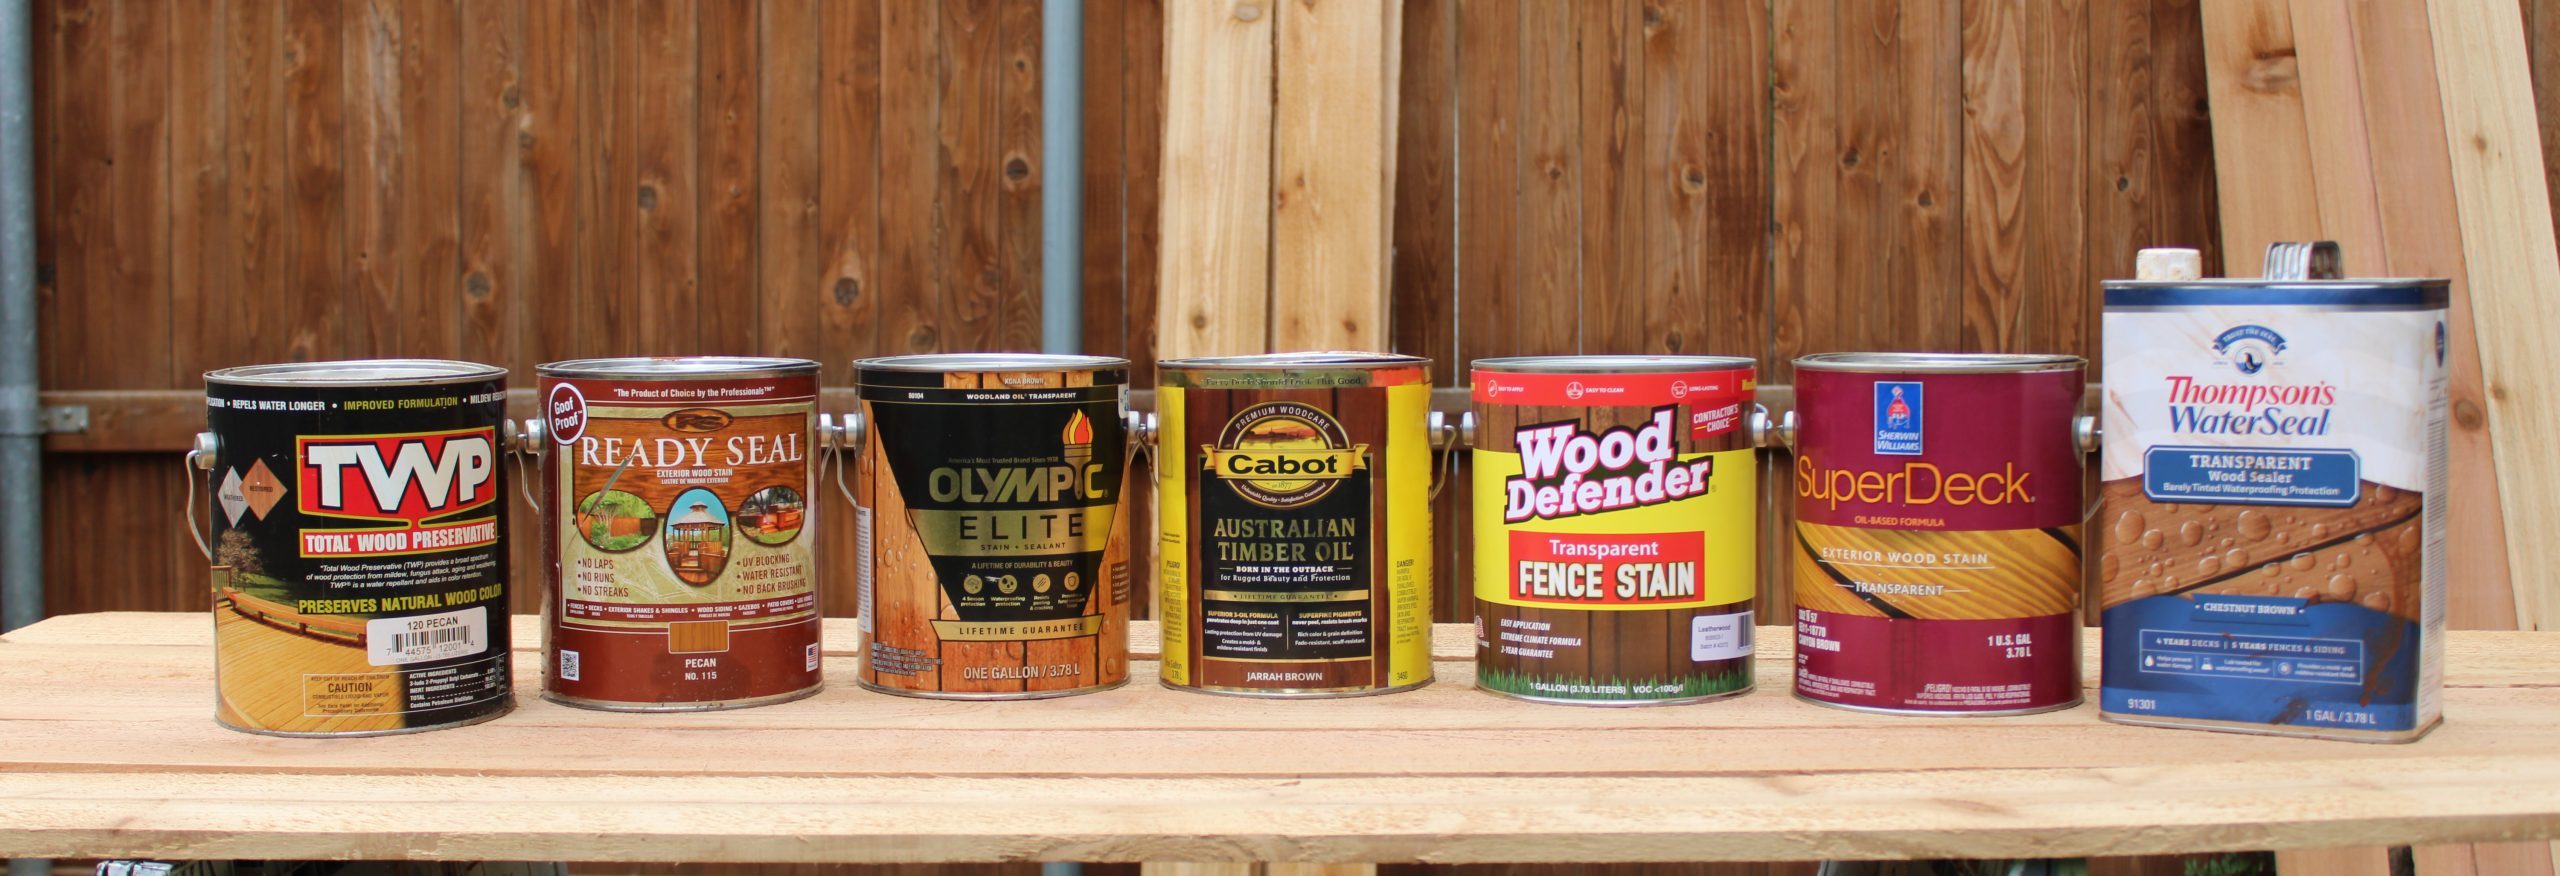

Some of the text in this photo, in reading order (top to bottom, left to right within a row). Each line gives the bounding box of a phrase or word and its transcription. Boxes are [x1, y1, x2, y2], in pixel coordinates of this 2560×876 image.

[631, 389, 659, 397] Product
[661, 388, 668, 397] of
[670, 388, 695, 397] Choice
[697, 388, 706, 399] by
[707, 388, 719, 397] the
[1028, 392, 1076, 400] TRANSPARENT
[2165, 376, 2336, 412] Thompson's
[232, 400, 257, 410] REPELS
[259, 400, 286, 410] WATER
[289, 401, 325, 410] LONGER
[344, 400, 394, 410] IMPROVED
[398, 396, 458, 409] FORMULATION
[470, 394, 492, 404] MILDEW
[554, 397, 574, 414] Goof
[1235, 405, 1331, 430] PREMIUM WOODCARE
[1693, 403, 1738, 424] CONTRACTOR'S
[1707, 420, 1730, 433] CHOICE
[2168, 406, 2331, 436] WaterSeal
[1878, 430, 1919, 441] SHERWIN
[580, 433, 802, 467] READY SEAL
[1514, 407, 1676, 481] Wood
[1877, 440, 1920, 451] WILLIAMS
[1228, 454, 1337, 475] Cabot
[2189, 454, 2312, 471] TRANSPARENT
[308, 438, 492, 511] TWP
[657, 468, 732, 478] EXTERIOR WOOD STAIN
[2208, 470, 2293, 484] Wood Sealer
[1504, 458, 1712, 522] Defender
[2163, 483, 2340, 496] Barely Tinted Waterproofing Protection
[960, 513, 1084, 540] ELITE
[1214, 517, 1356, 538] AUSTRALIAN
[1854, 515, 1944, 527] OIL-BASED FORMULA
[357, 531, 407, 552] WOOD
[413, 522, 496, 550] PRESERVATIVE
[1024, 542, 1066, 550] SEALANT
[1218, 541, 1354, 562] TIMBER OIL
[1549, 539, 1659, 560] Transparent
[742, 554, 790, 568] UV BLOCKING
[1822, 546, 1989, 565] EXTERIOR WOOD STAIN
[340, 564, 360, 572] Wood
[362, 563, 402, 571] Preservative
[404, 562, 424, 570] (TWP)
[582, 558, 614, 570] NO LAPS
[1014, 561, 1047, 569] DURABILITY
[1236, 565, 1334, 573] BORN IN THE OUTBACK
[333, 572, 366, 582] protection
[368, 572, 382, 580] from
[410, 570, 431, 578] fungus
[582, 572, 614, 583] NO RUNS
[742, 566, 802, 581] WATER RESISTANT
[1220, 574, 1350, 583] for Rugged Beauty and Protection
[1518, 560, 1695, 598] FENCE STAIN
[582, 586, 628, 597] NO STREAKS
[742, 578, 806, 595] NO BACK BRUSHING
[1854, 581, 1944, 596] TRANSPARENT
[299, 584, 502, 614] PRESERVES NATURAL WOOD COLOR
[2204, 602, 2295, 615] CHESTNUT BROWN
[407, 616, 458, 630] 120 PECAN
[960, 623, 1084, 635] LIFETIME GUARANTEE
[1500, 618, 1550, 632] EASY APPLICATION
[1500, 632, 1582, 647] EXTREME CLIMATE FORMULA
[1816, 638, 1840, 652] BROWN
[1988, 634, 2031, 647] 1 U.S. GAL
[2163, 638, 2190, 646] YEARS
[2191, 639, 2220, 648] DECKS
[2238, 642, 2266, 650] YEARS
[2268, 643, 2302, 652] FENCES
[2313, 645, 2345, 654] SIDING
[405, 642, 462, 656] 44575 12001
[1518, 647, 1553, 659] GUARANTEE
[2026, 647, 2031, 656] L
[685, 658, 717, 668] PECAN
[685, 671, 717, 680] NO. 115
[963, 663, 1080, 680] ONE GALLON 3.78 L
[1247, 672, 1323, 682] JARRAH BROWN
[328, 682, 373, 693] CAUTION
[1535, 683, 1568, 692] GALLON
[1570, 684, 1590, 694] (3.78
[1592, 684, 1626, 695] LITERS)
[1633, 685, 1653, 694] VOC
[2128, 698, 2156, 710] 91301
[2306, 710, 2376, 724] 1 GAL 3.78 L
